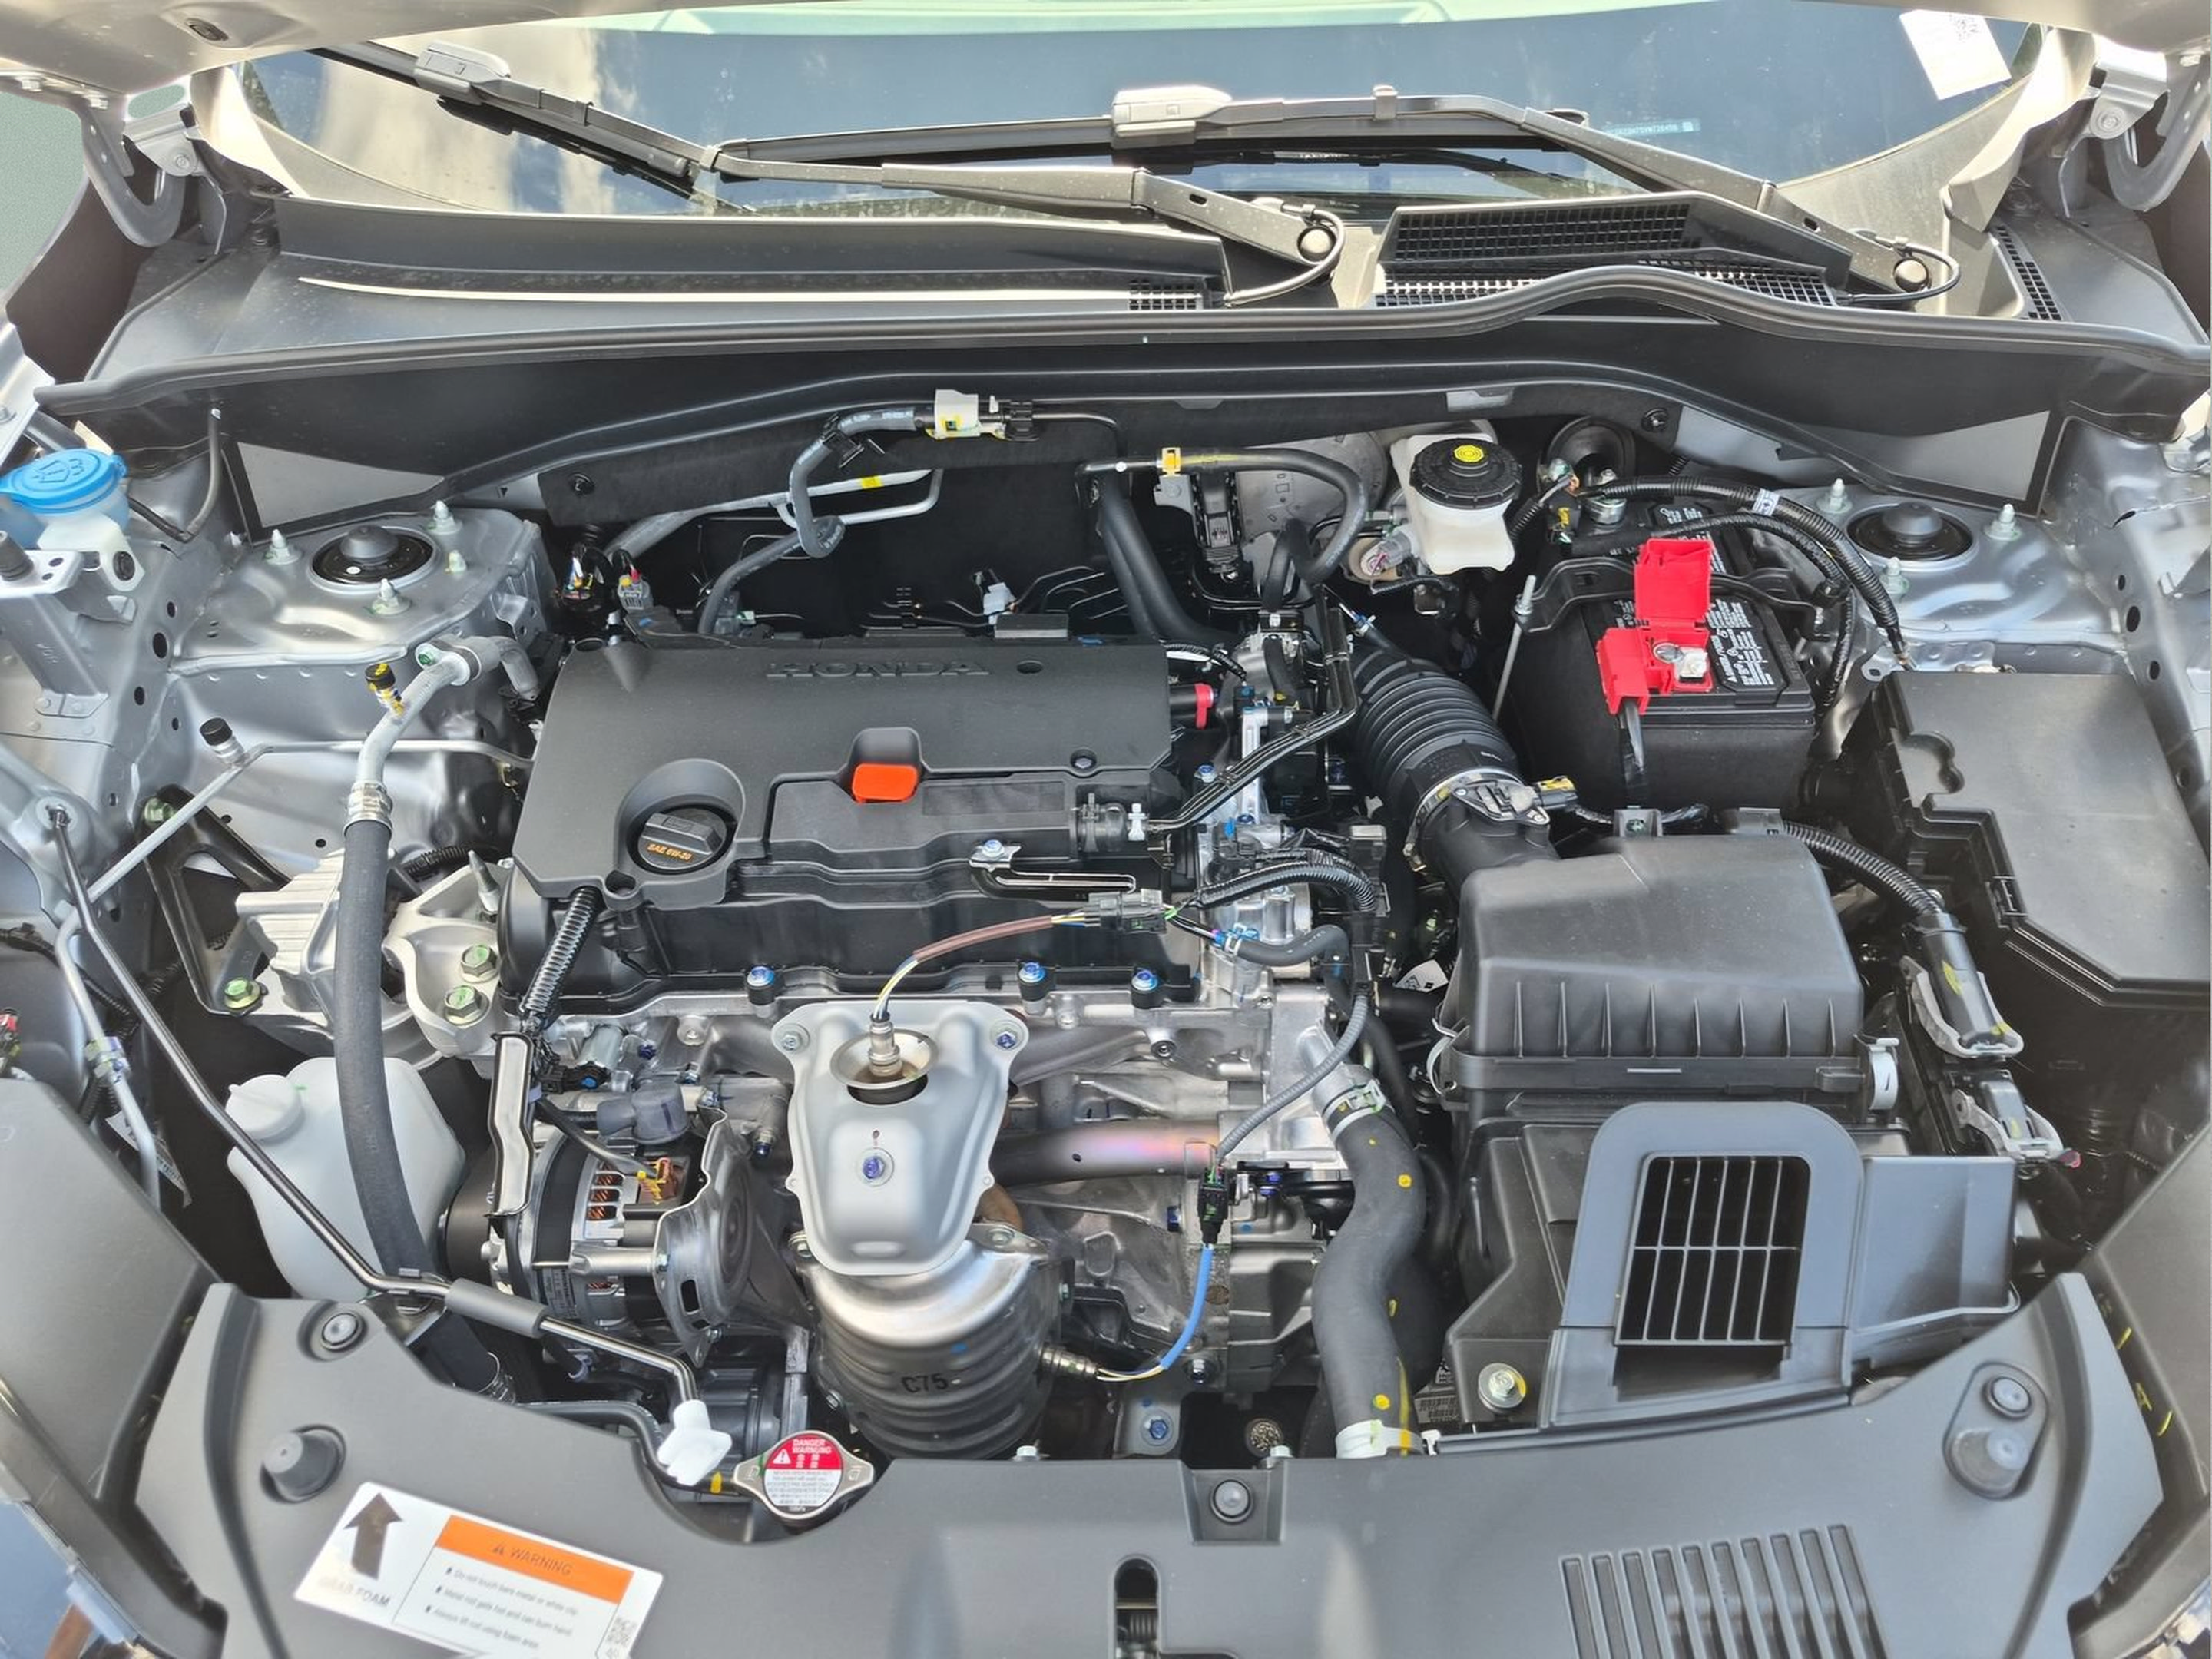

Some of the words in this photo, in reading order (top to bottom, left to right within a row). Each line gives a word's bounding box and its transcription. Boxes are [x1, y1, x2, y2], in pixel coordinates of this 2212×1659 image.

[766, 661, 989, 677] HONDA
[647, 843, 667, 854] SAE
[901, 1372, 949, 1393] C75
[510, 1548, 572, 1575] WARNING
[356, 1586, 391, 1607] FOAM
